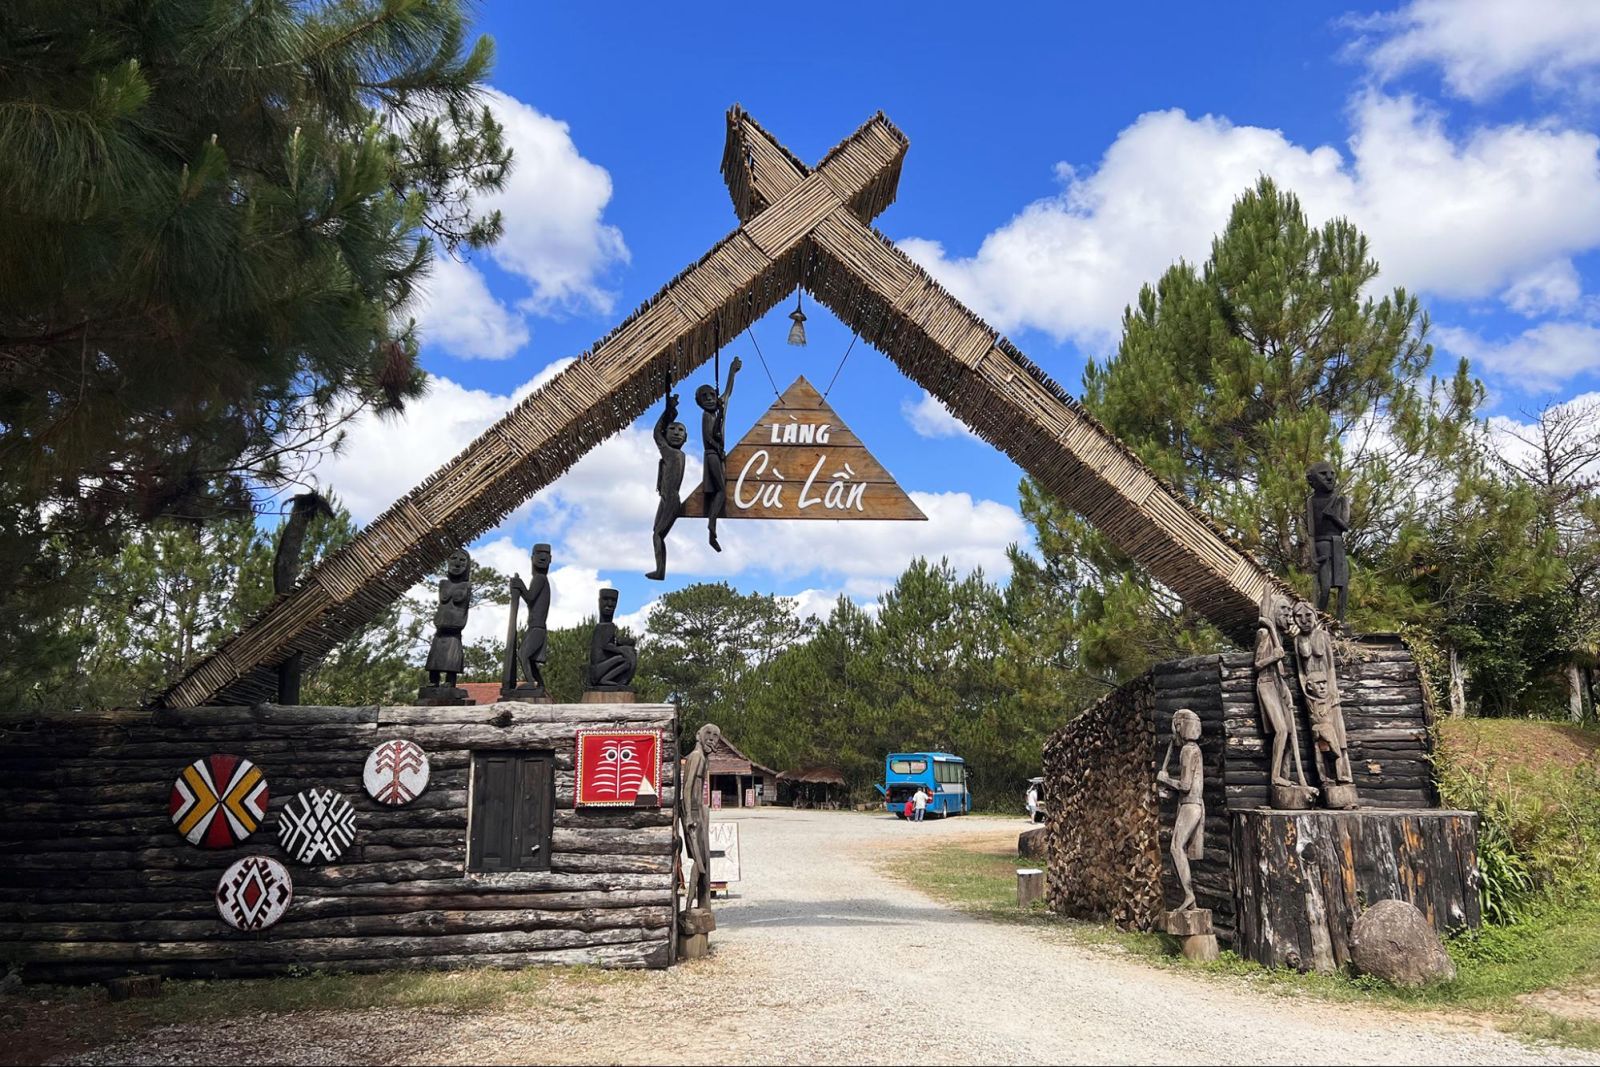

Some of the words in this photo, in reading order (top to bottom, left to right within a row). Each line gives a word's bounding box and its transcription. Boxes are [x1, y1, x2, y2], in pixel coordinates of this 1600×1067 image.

[770, 414, 830, 444] LÀNG
[734, 450, 784, 509] Cù
[798, 454, 867, 511] Lần
